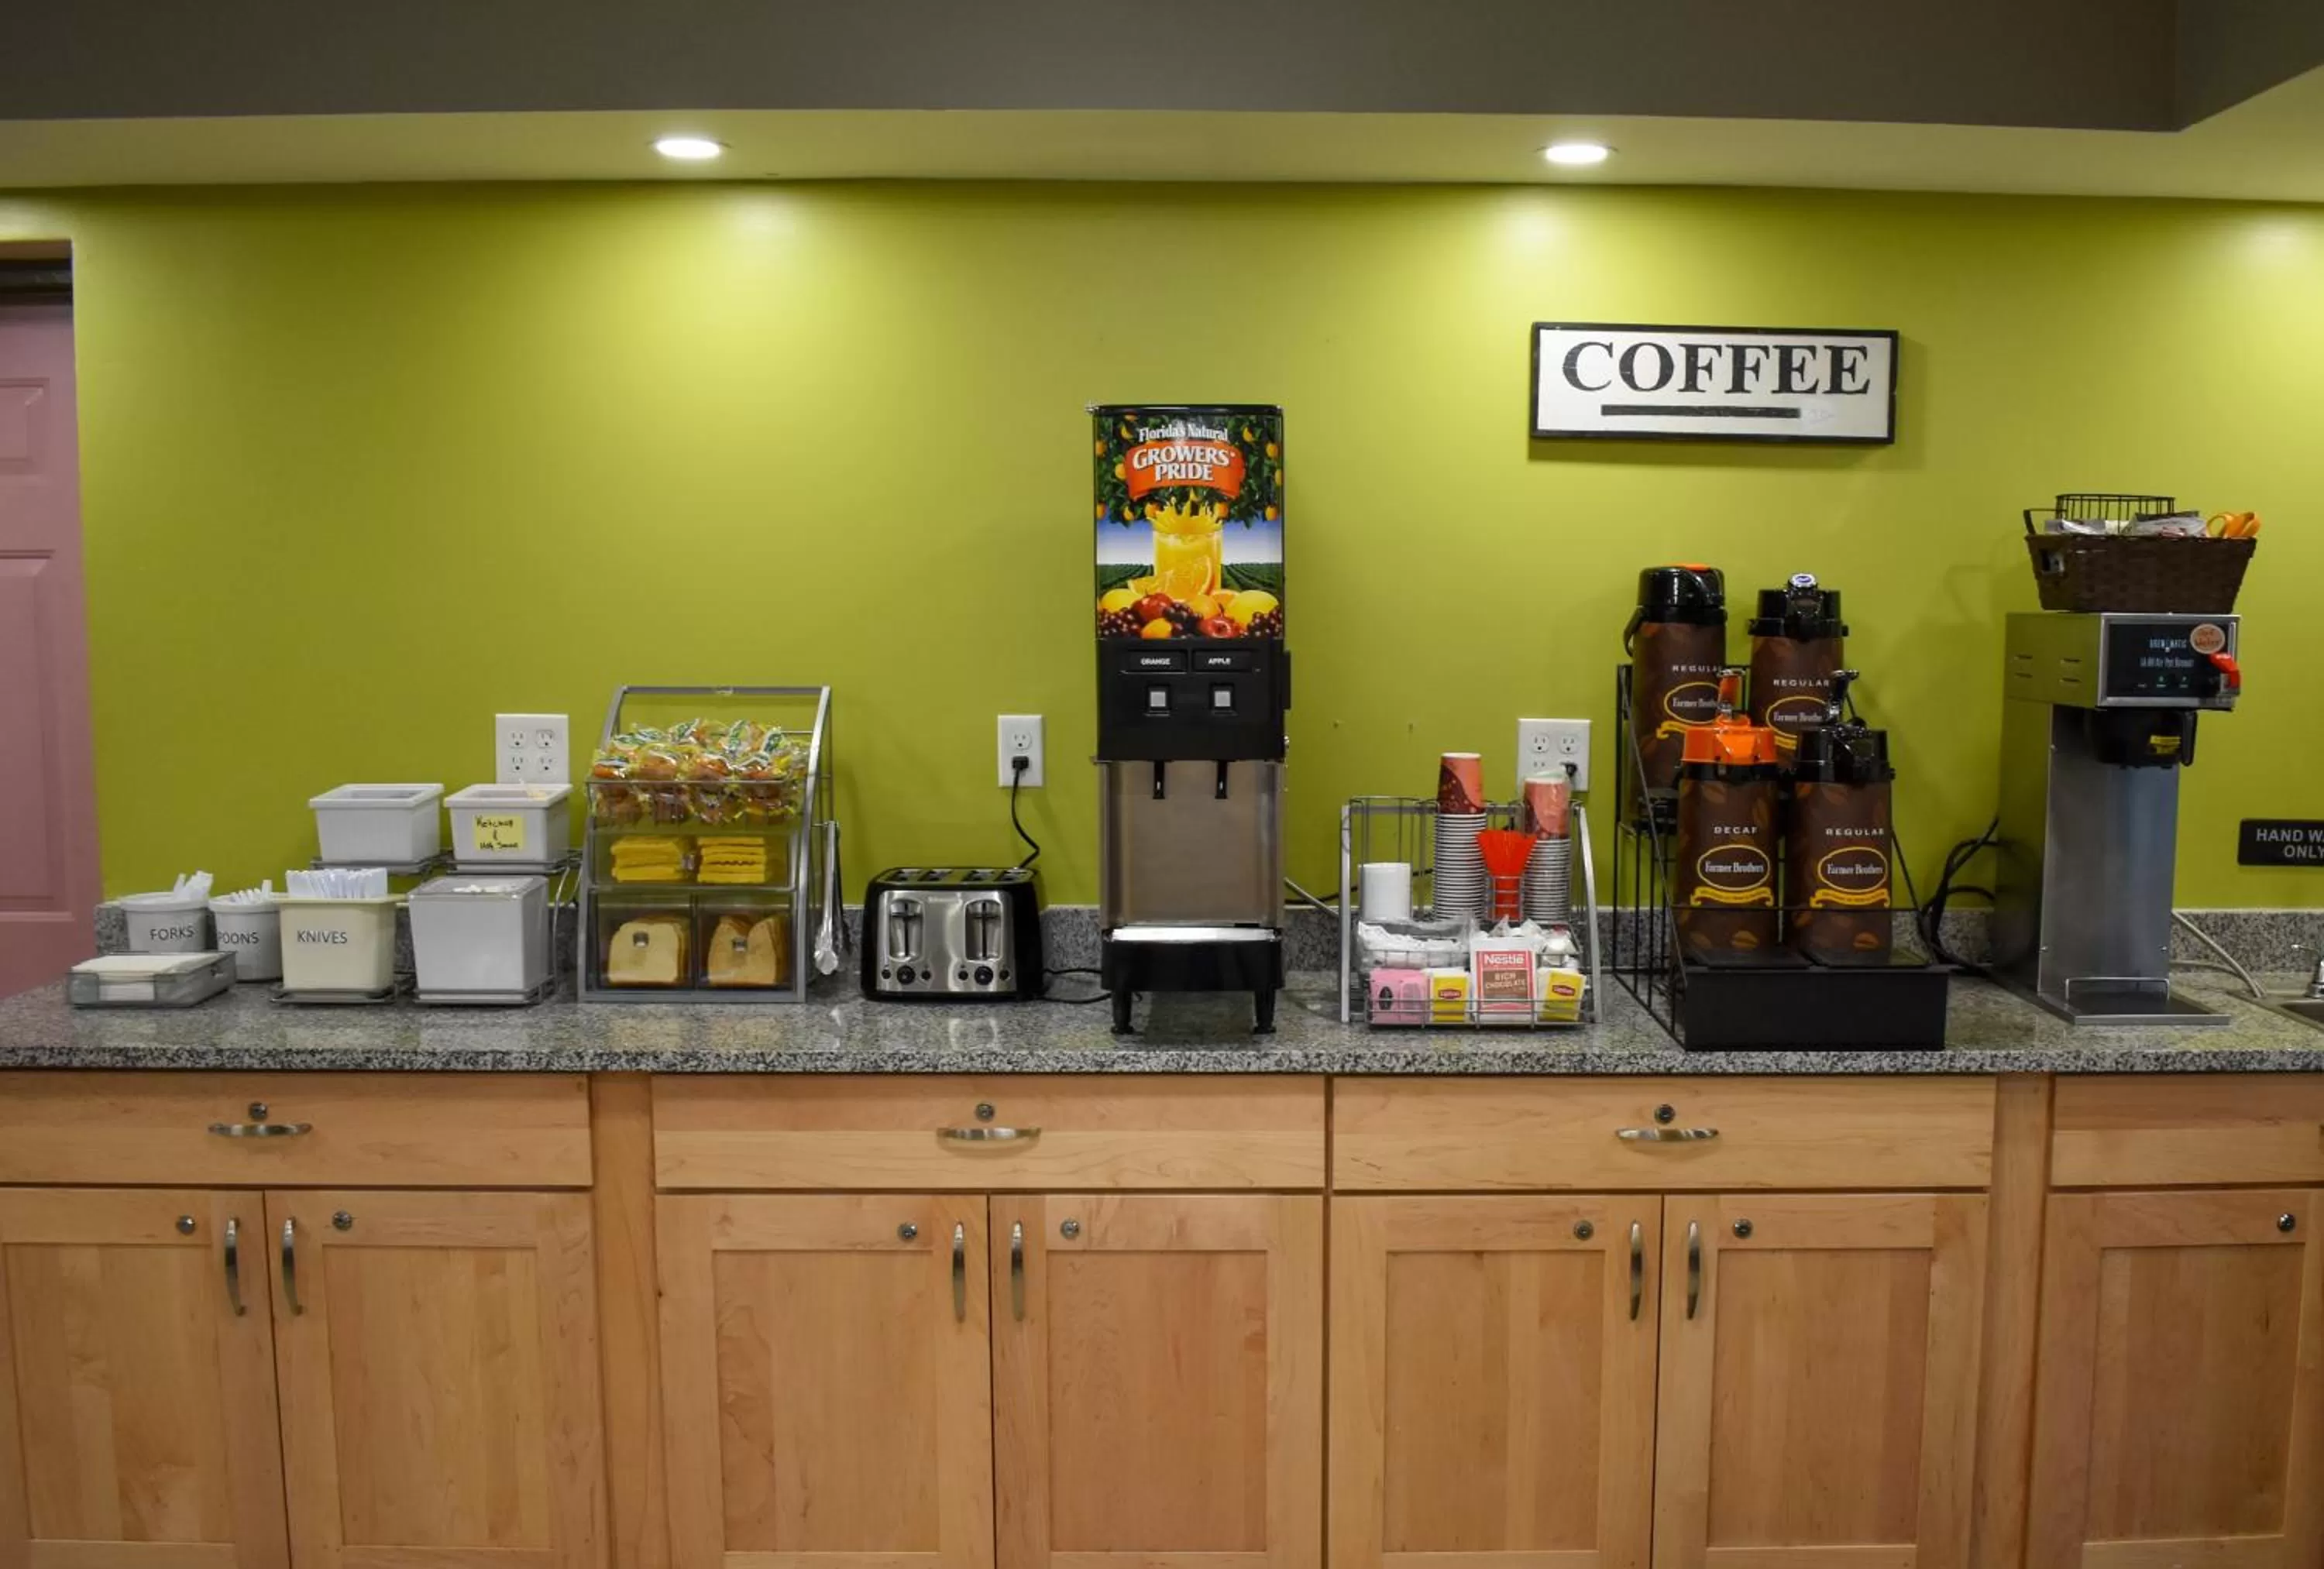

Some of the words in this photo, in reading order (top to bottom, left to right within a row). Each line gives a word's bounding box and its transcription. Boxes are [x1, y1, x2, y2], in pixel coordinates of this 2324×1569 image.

[1562, 342, 1871, 394] COFFEE
[1188, 423, 1228, 441] Natural
[1155, 462, 1215, 481] PRIDE
[1772, 678, 1830, 687] REGULAR
[1824, 827, 1885, 836] REGULAR
[2256, 828, 2304, 843] HAND
[2308, 829, 2324, 843] W
[1705, 860, 1732, 874] Farmer
[1827, 863, 1854, 874] Farmer
[150, 925, 195, 941] FORKS
[297, 929, 348, 944] KNIVES
